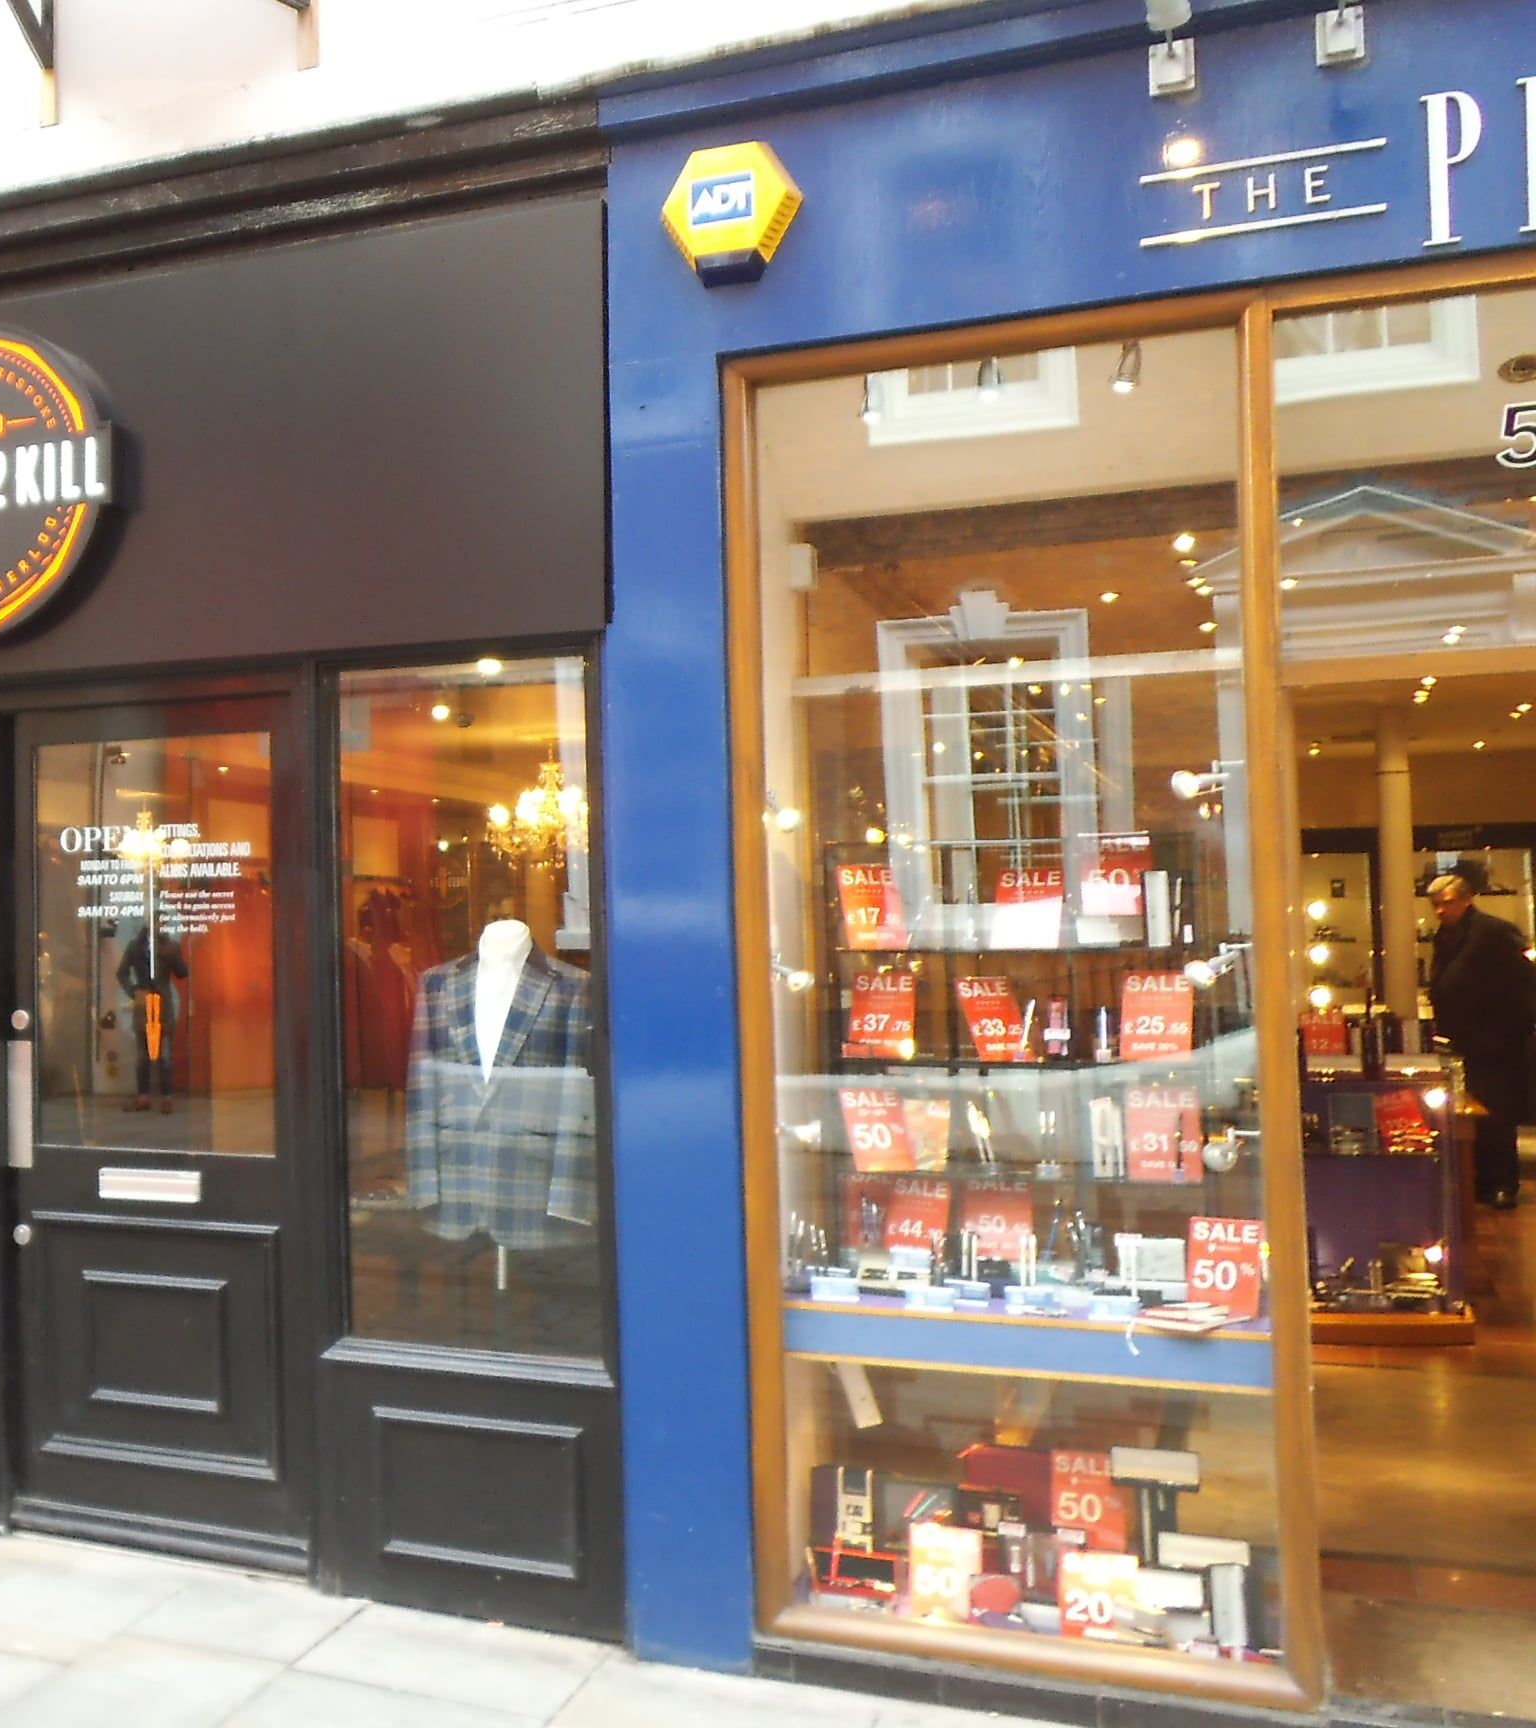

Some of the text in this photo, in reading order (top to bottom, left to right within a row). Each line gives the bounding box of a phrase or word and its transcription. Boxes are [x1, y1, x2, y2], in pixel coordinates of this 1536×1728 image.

[692, 179, 753, 219] ADT
[1192, 164, 1332, 220] THE
[14, 435, 108, 507] KILL
[230, 841, 251, 857] AND
[103, 873, 119, 885] TO
[120, 873, 145, 885] 6PM
[840, 868, 894, 886] SALE
[1000, 869, 1062, 888] SALE
[103, 905, 119, 917] TO
[120, 905, 145, 917] 4PM
[855, 974, 913, 992] SALE
[958, 980, 1009, 998] SALE
[1126, 974, 1190, 993] SALE
[842, 1090, 898, 1108] SALE
[1128, 1090, 1195, 1109] SALE
[894, 1178, 948, 1199] SALE
[1193, 1221, 1260, 1244] SALE
